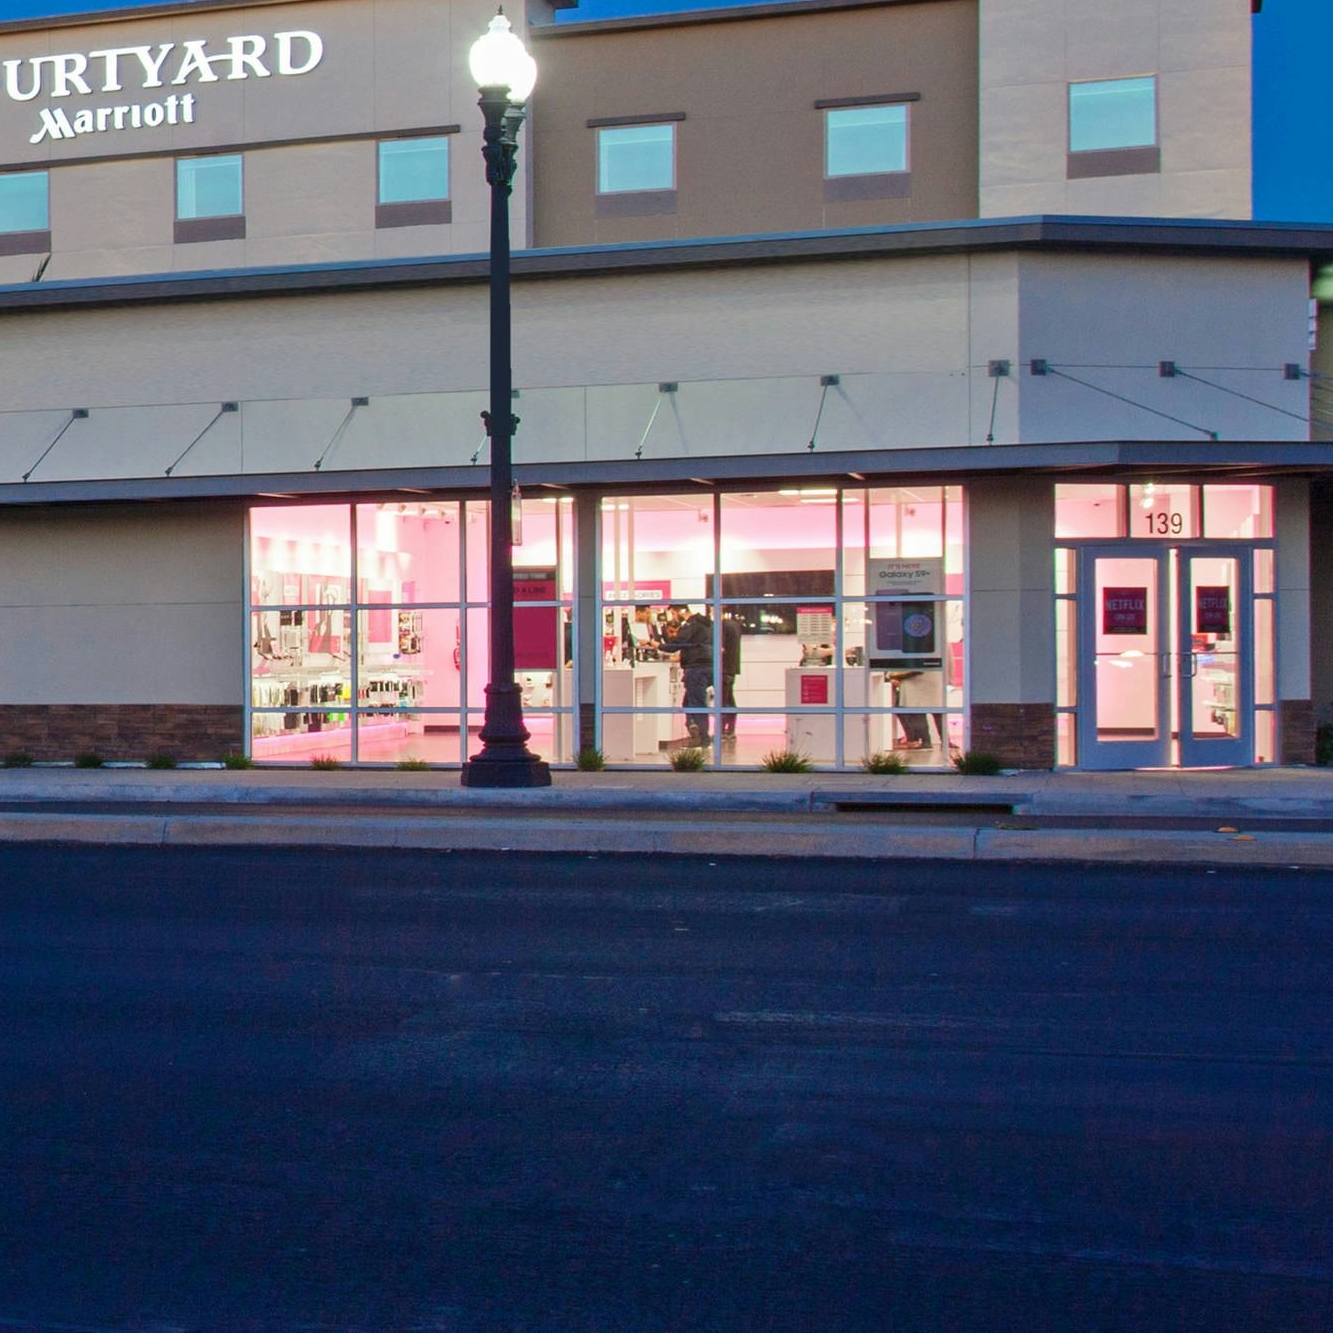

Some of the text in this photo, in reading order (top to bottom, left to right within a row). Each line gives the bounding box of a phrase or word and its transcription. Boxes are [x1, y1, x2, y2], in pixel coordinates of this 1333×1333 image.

[28, 92, 196, 144] Marriott
[1145, 512, 1183, 535] 139
[879, 570, 914, 579] Galaxy
[1105, 598, 1145, 611] NETFLIX
